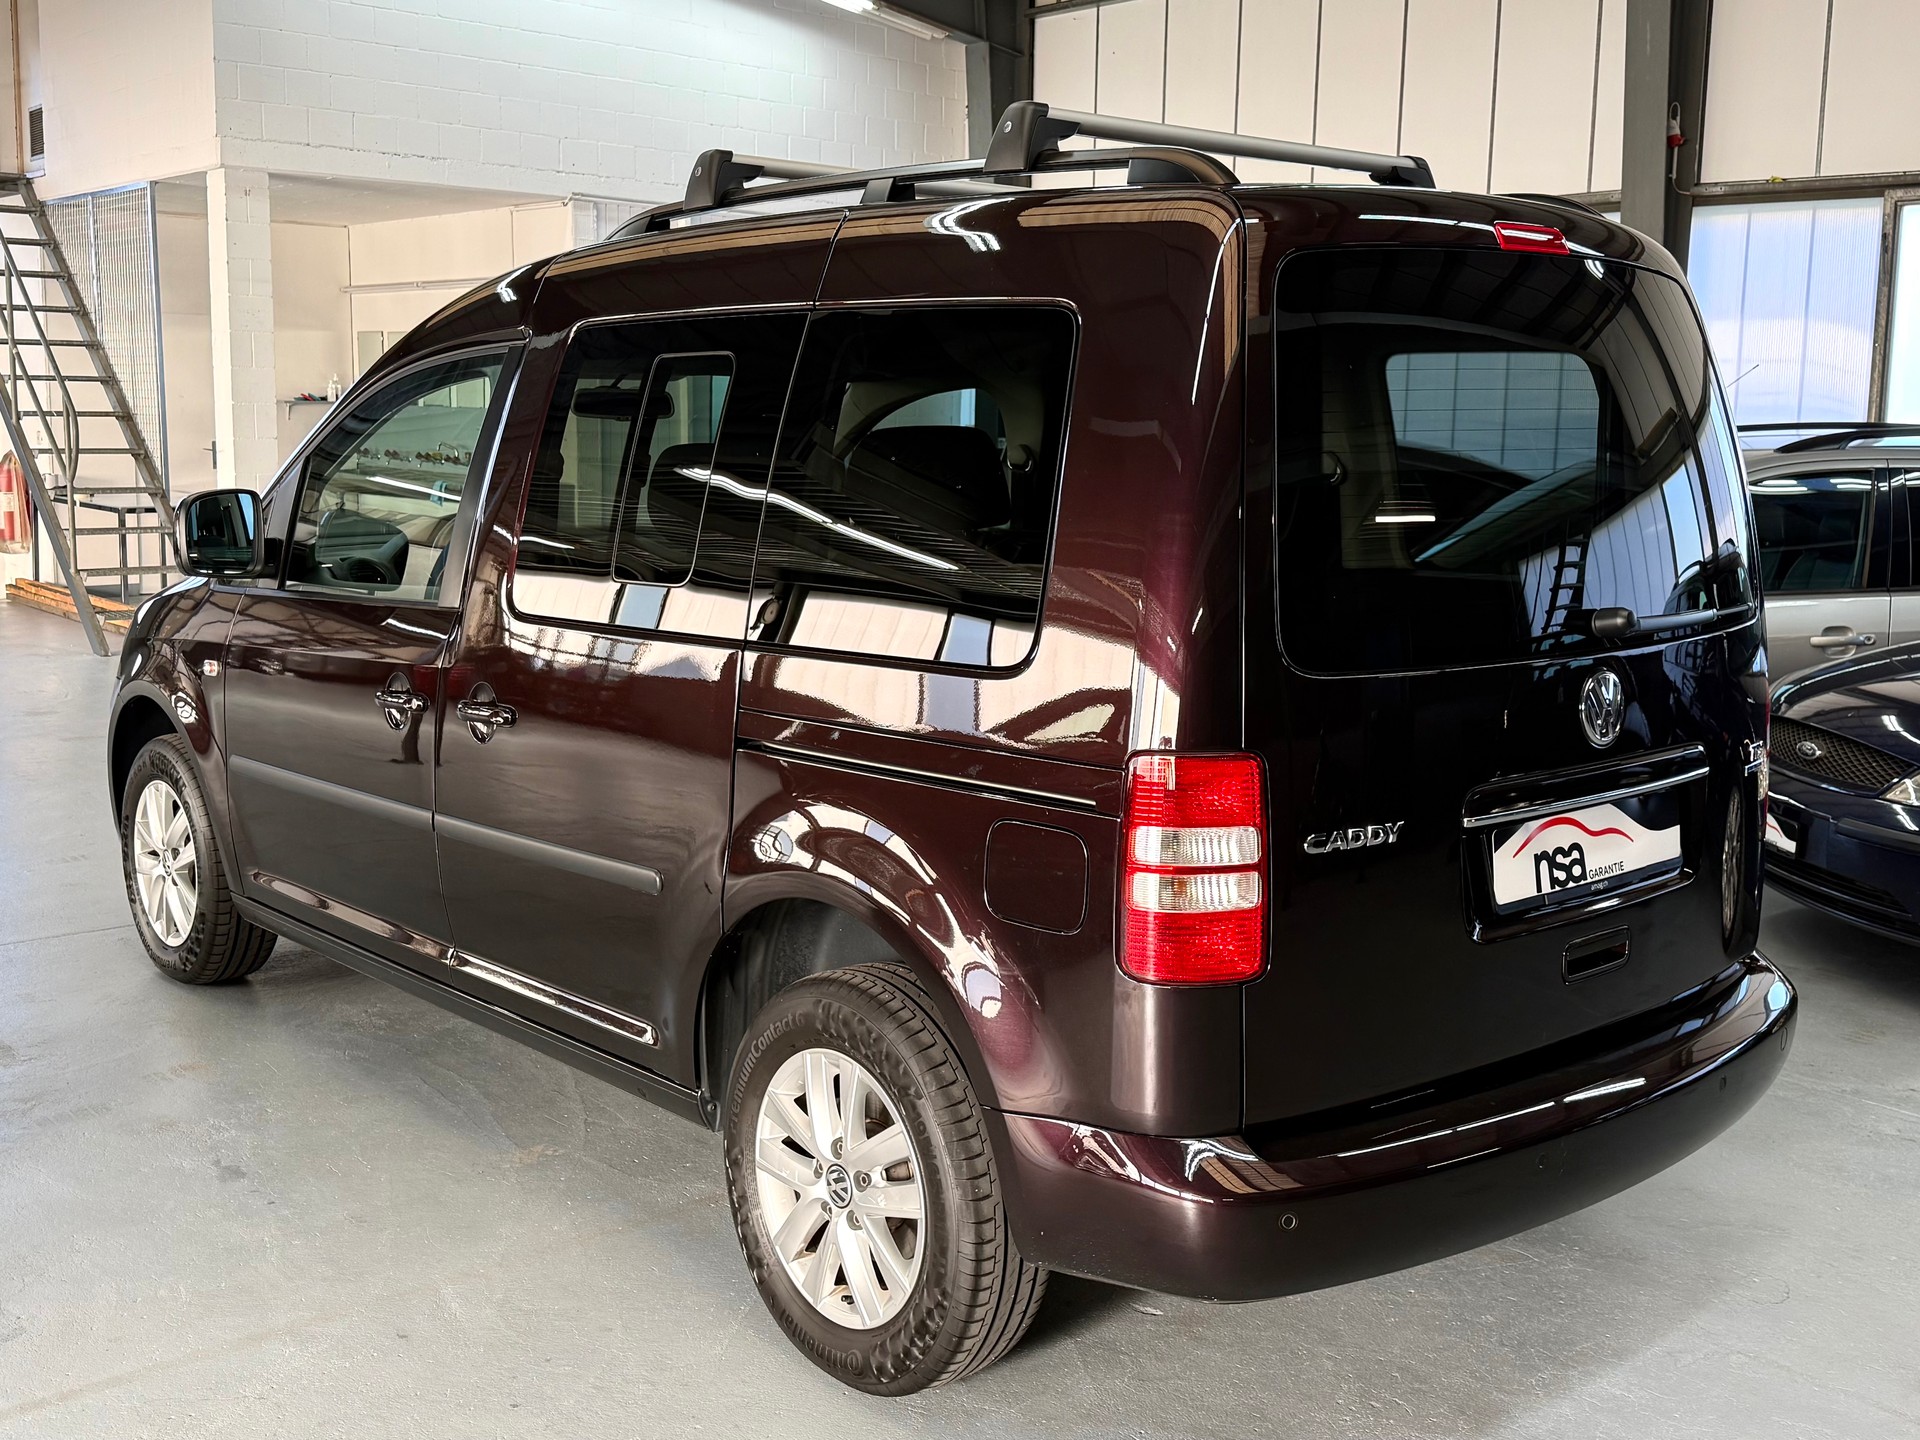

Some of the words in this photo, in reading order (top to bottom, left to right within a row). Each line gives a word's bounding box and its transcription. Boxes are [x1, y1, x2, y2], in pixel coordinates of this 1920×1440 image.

[1303, 820, 1405, 854] CADDY
[1533, 842, 1588, 893] nsa
[1588, 861, 1625, 880] GARANTIE
